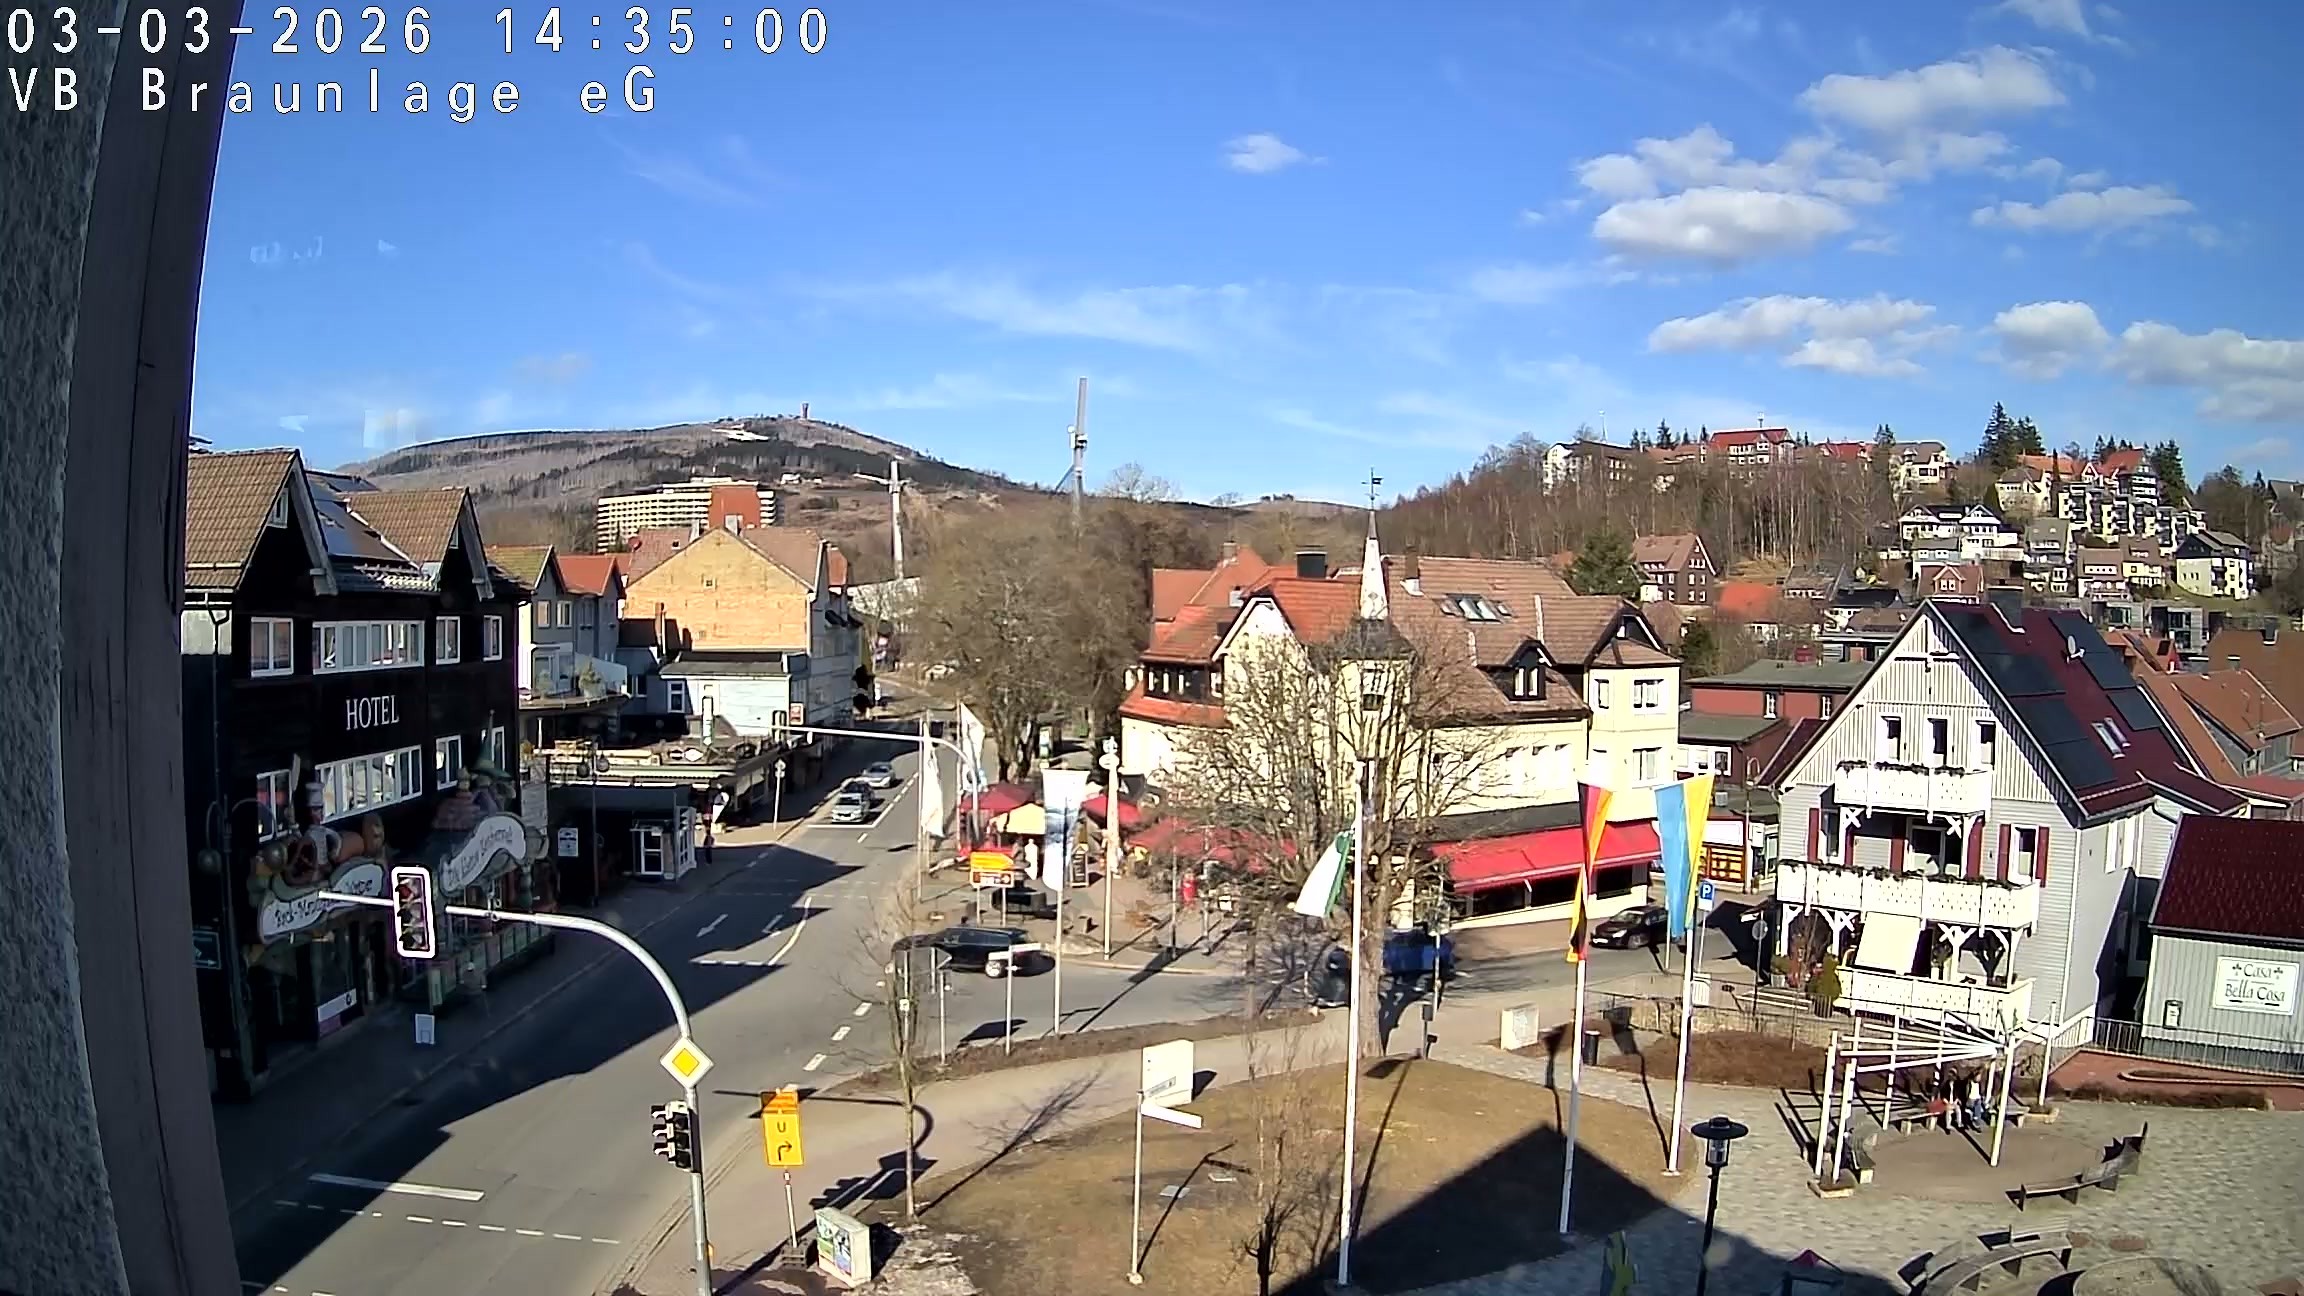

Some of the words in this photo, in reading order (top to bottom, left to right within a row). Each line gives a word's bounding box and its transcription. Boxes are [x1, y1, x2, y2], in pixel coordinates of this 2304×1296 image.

[345, 694, 400, 731] HOTEL
[1702, 884, 1712, 898] P
[2243, 963, 2272, 978] Casa
[2224, 980, 2253, 999] Bella
[776, 1121, 787, 1133] U
